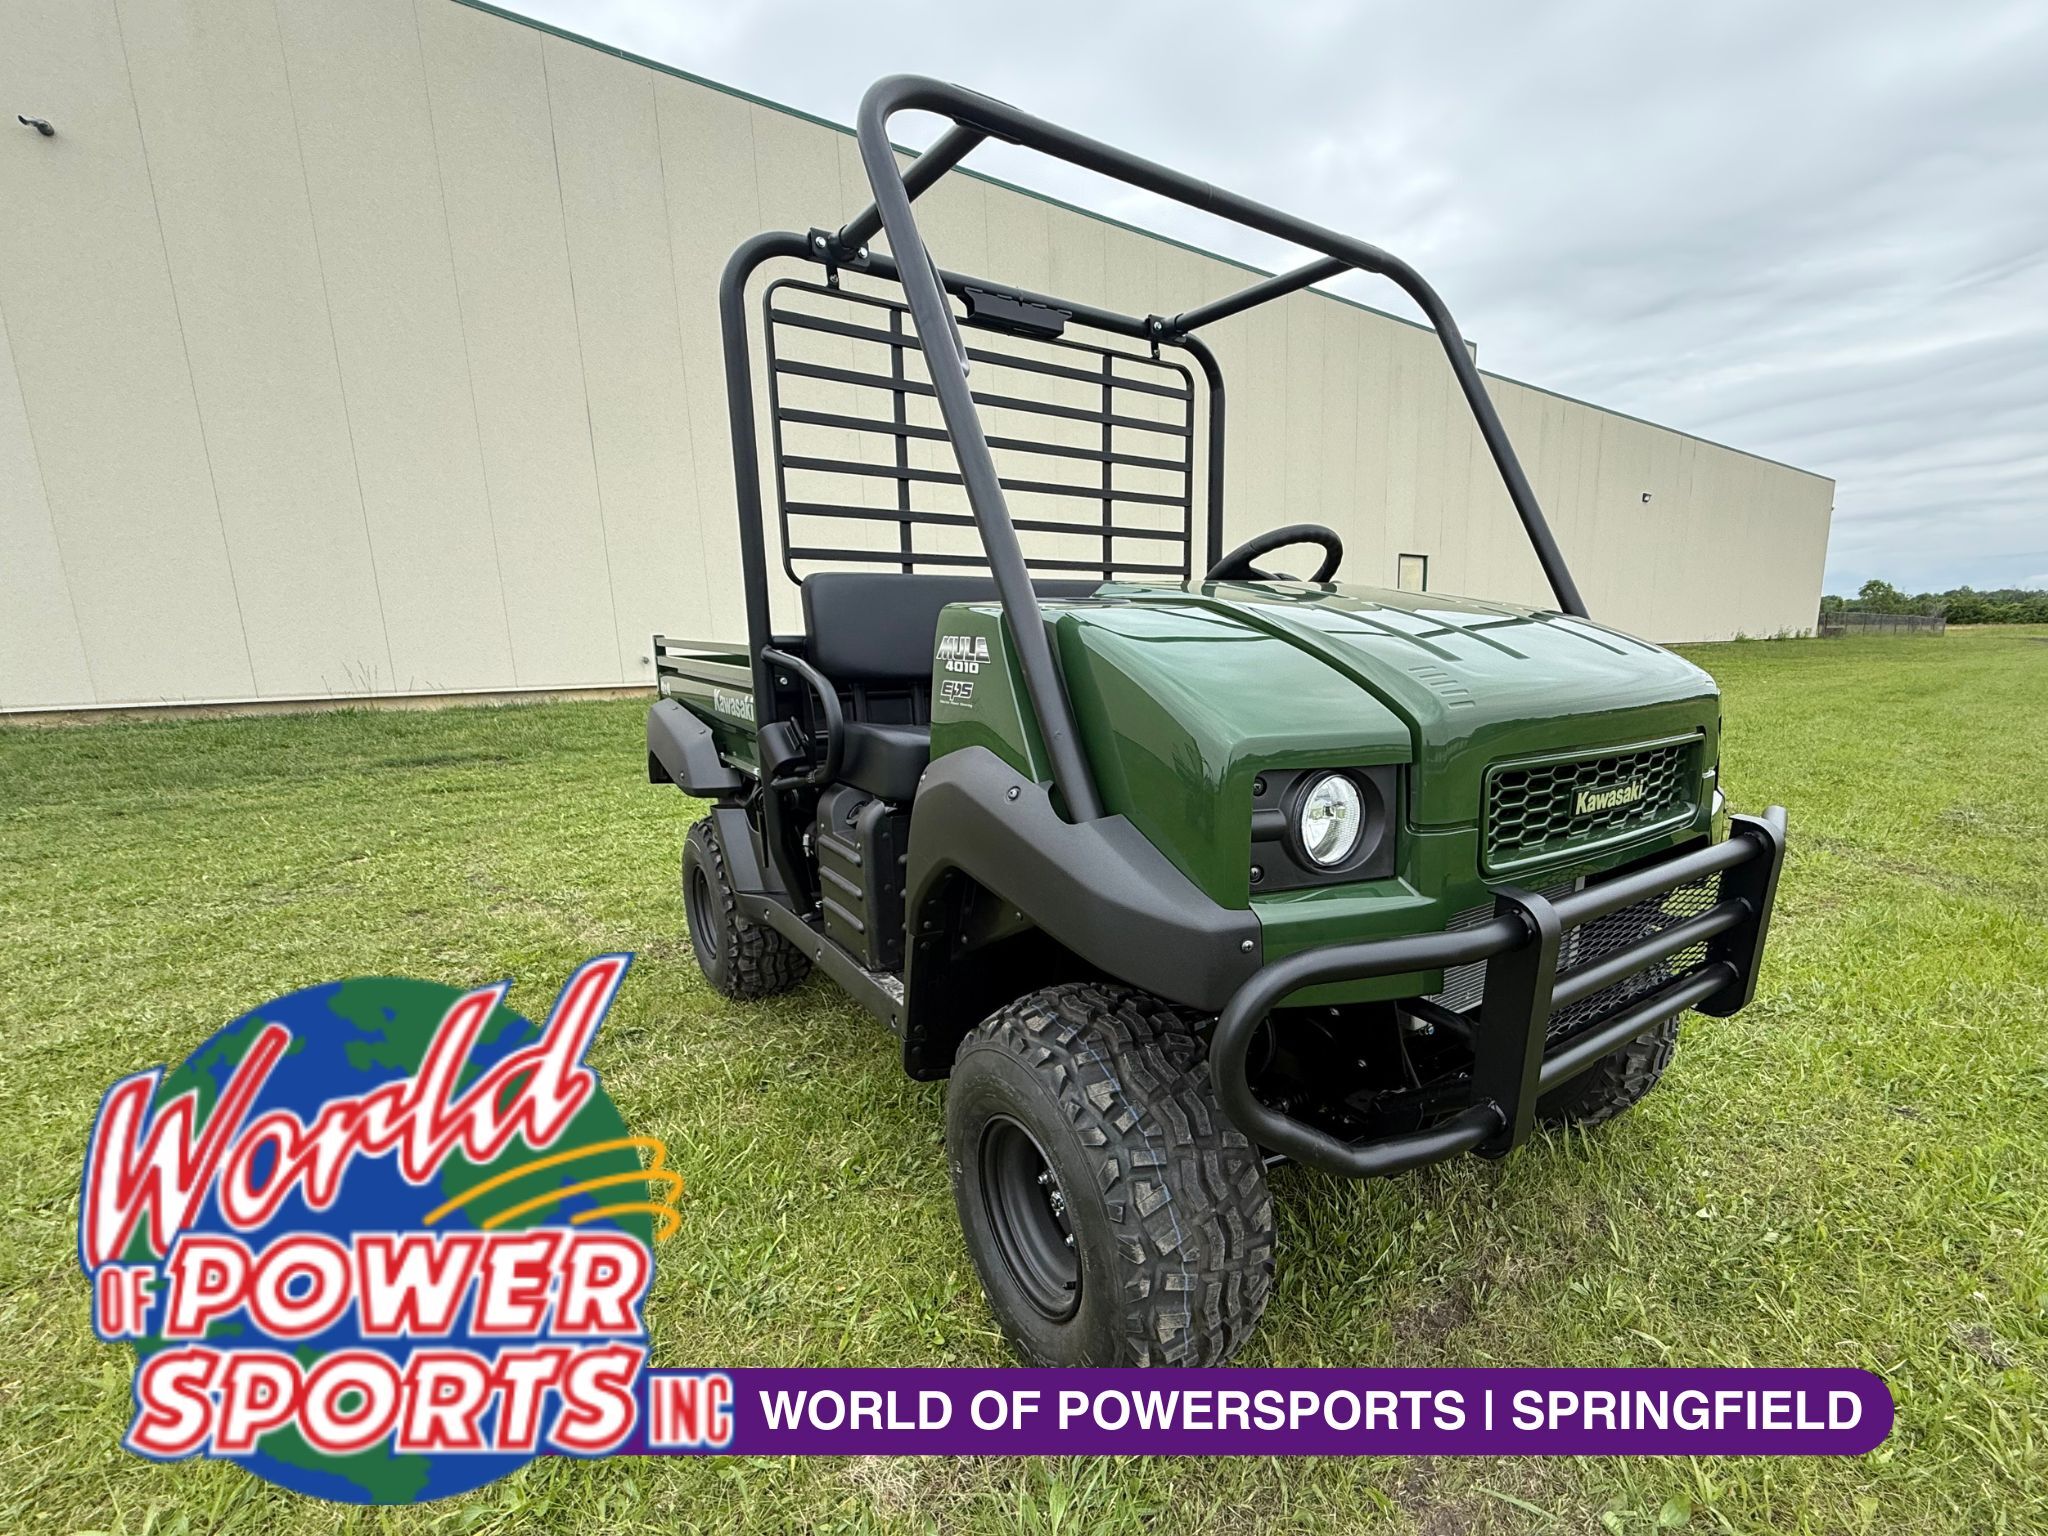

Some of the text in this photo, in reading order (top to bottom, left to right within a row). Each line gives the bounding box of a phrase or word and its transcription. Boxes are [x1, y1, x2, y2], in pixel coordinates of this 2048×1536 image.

[936, 635, 991, 664] MULE
[945, 661, 979, 674] 4010
[713, 688, 754, 721] Kawasaki
[1575, 779, 1644, 815] Kawasaki
